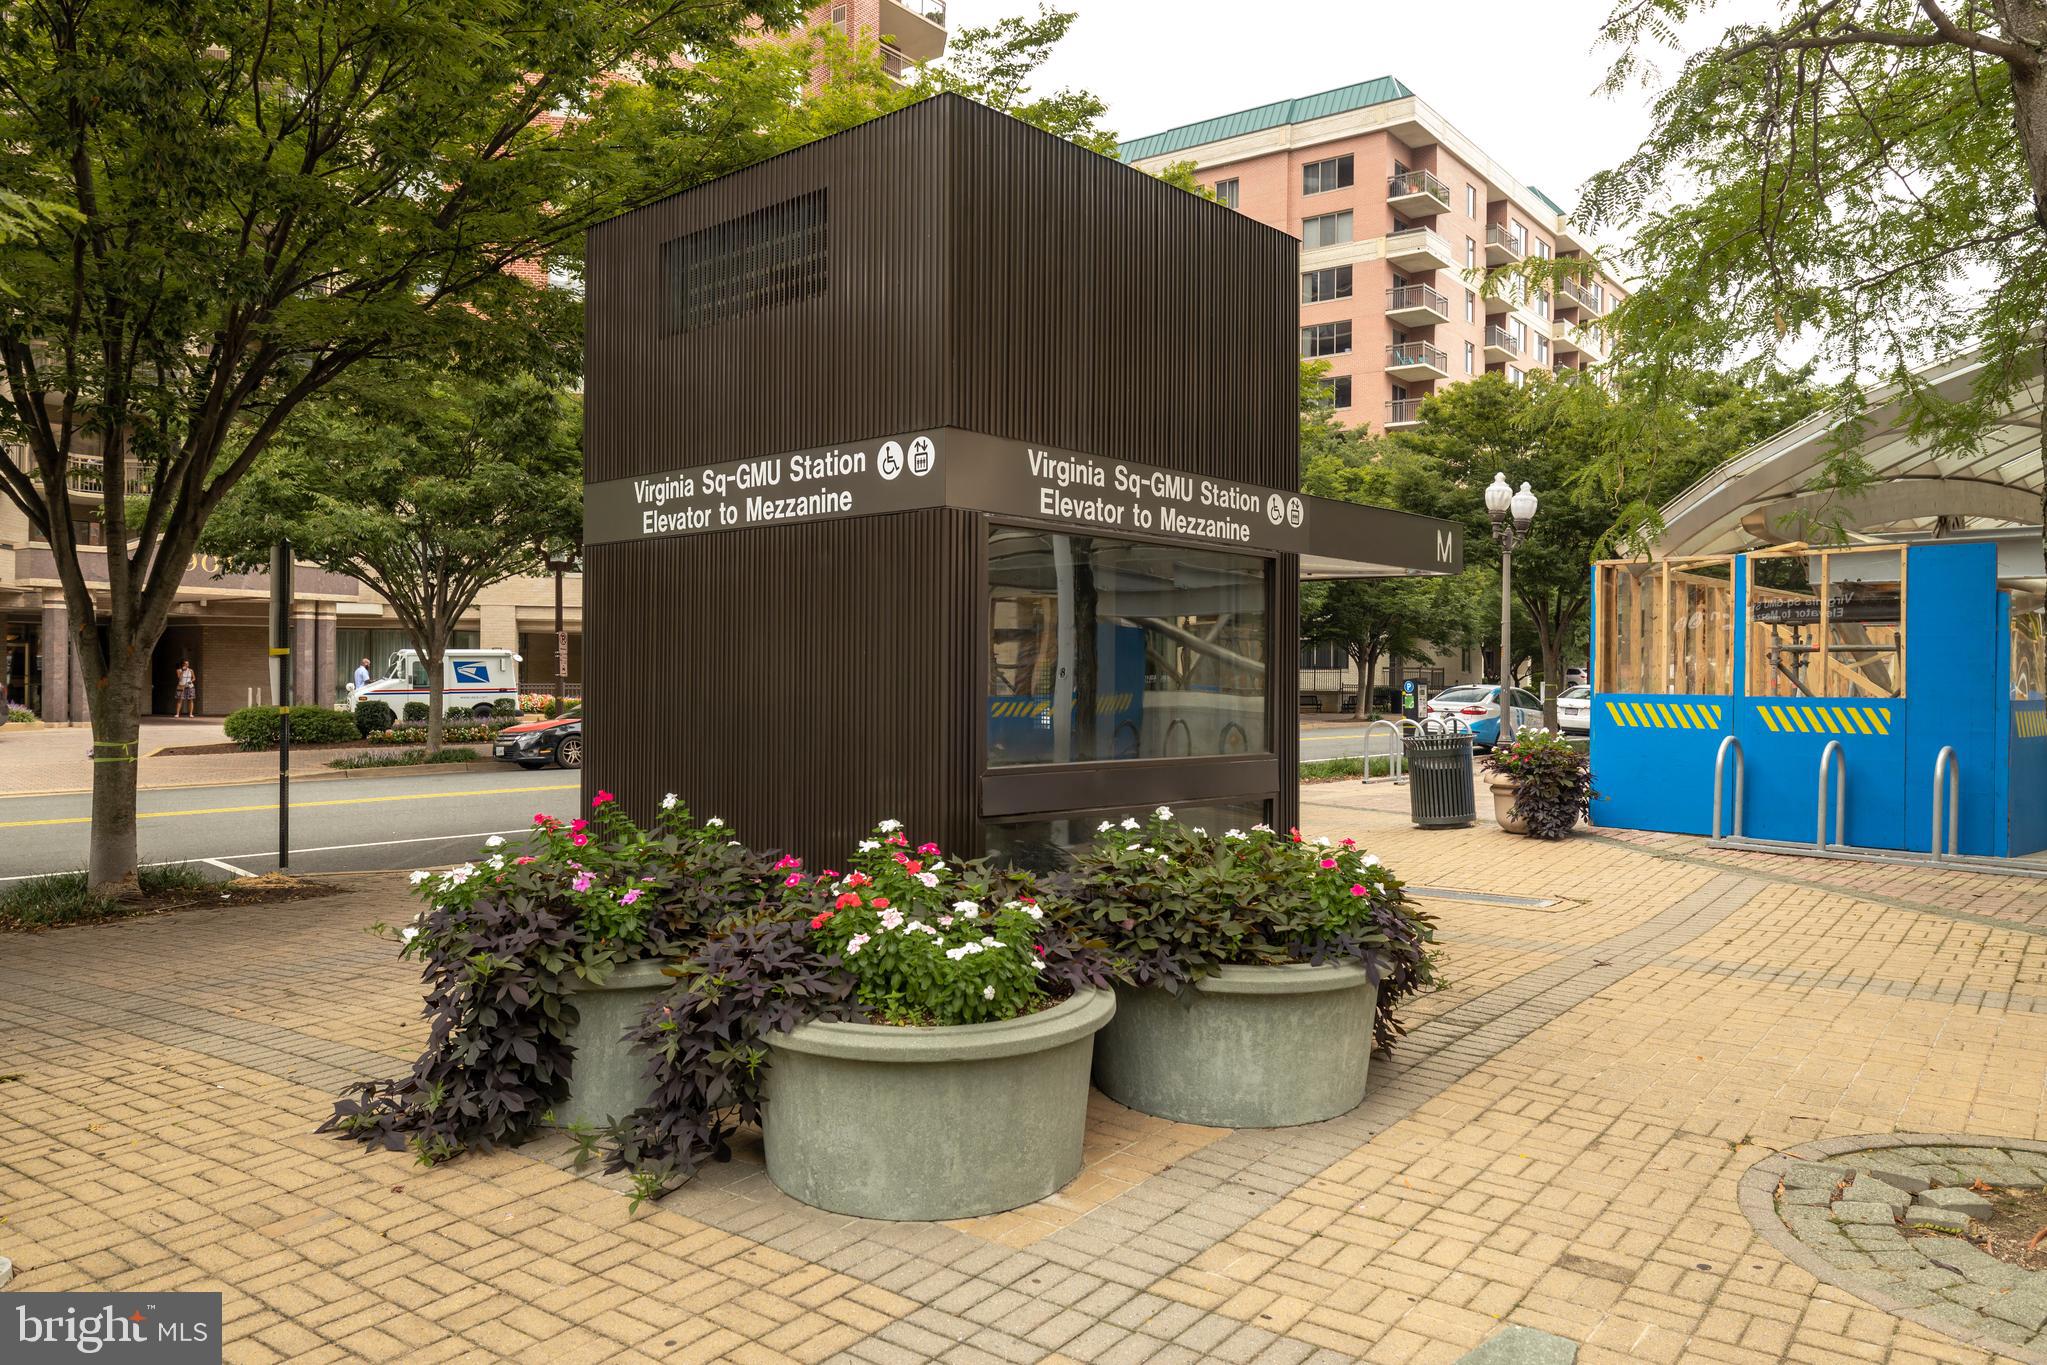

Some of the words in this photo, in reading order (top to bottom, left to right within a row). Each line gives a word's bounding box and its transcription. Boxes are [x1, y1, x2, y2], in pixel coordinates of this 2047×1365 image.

[634, 474, 694, 507] Virginia
[701, 458, 781, 497] Sq-GMU
[789, 449, 867, 483] Station
[1027, 448, 1105, 488] Virginia
[1114, 464, 1193, 502] Sq-GMU
[1200, 480, 1260, 513] Station
[643, 505, 712, 534] Elevator
[718, 502, 738, 526] to
[746, 486, 853, 523] Mezzanine
[1040, 487, 1125, 525] Elevator
[1132, 503, 1153, 528] to
[1160, 506, 1251, 542] Mezzanine
[1437, 529, 1452, 564] M
